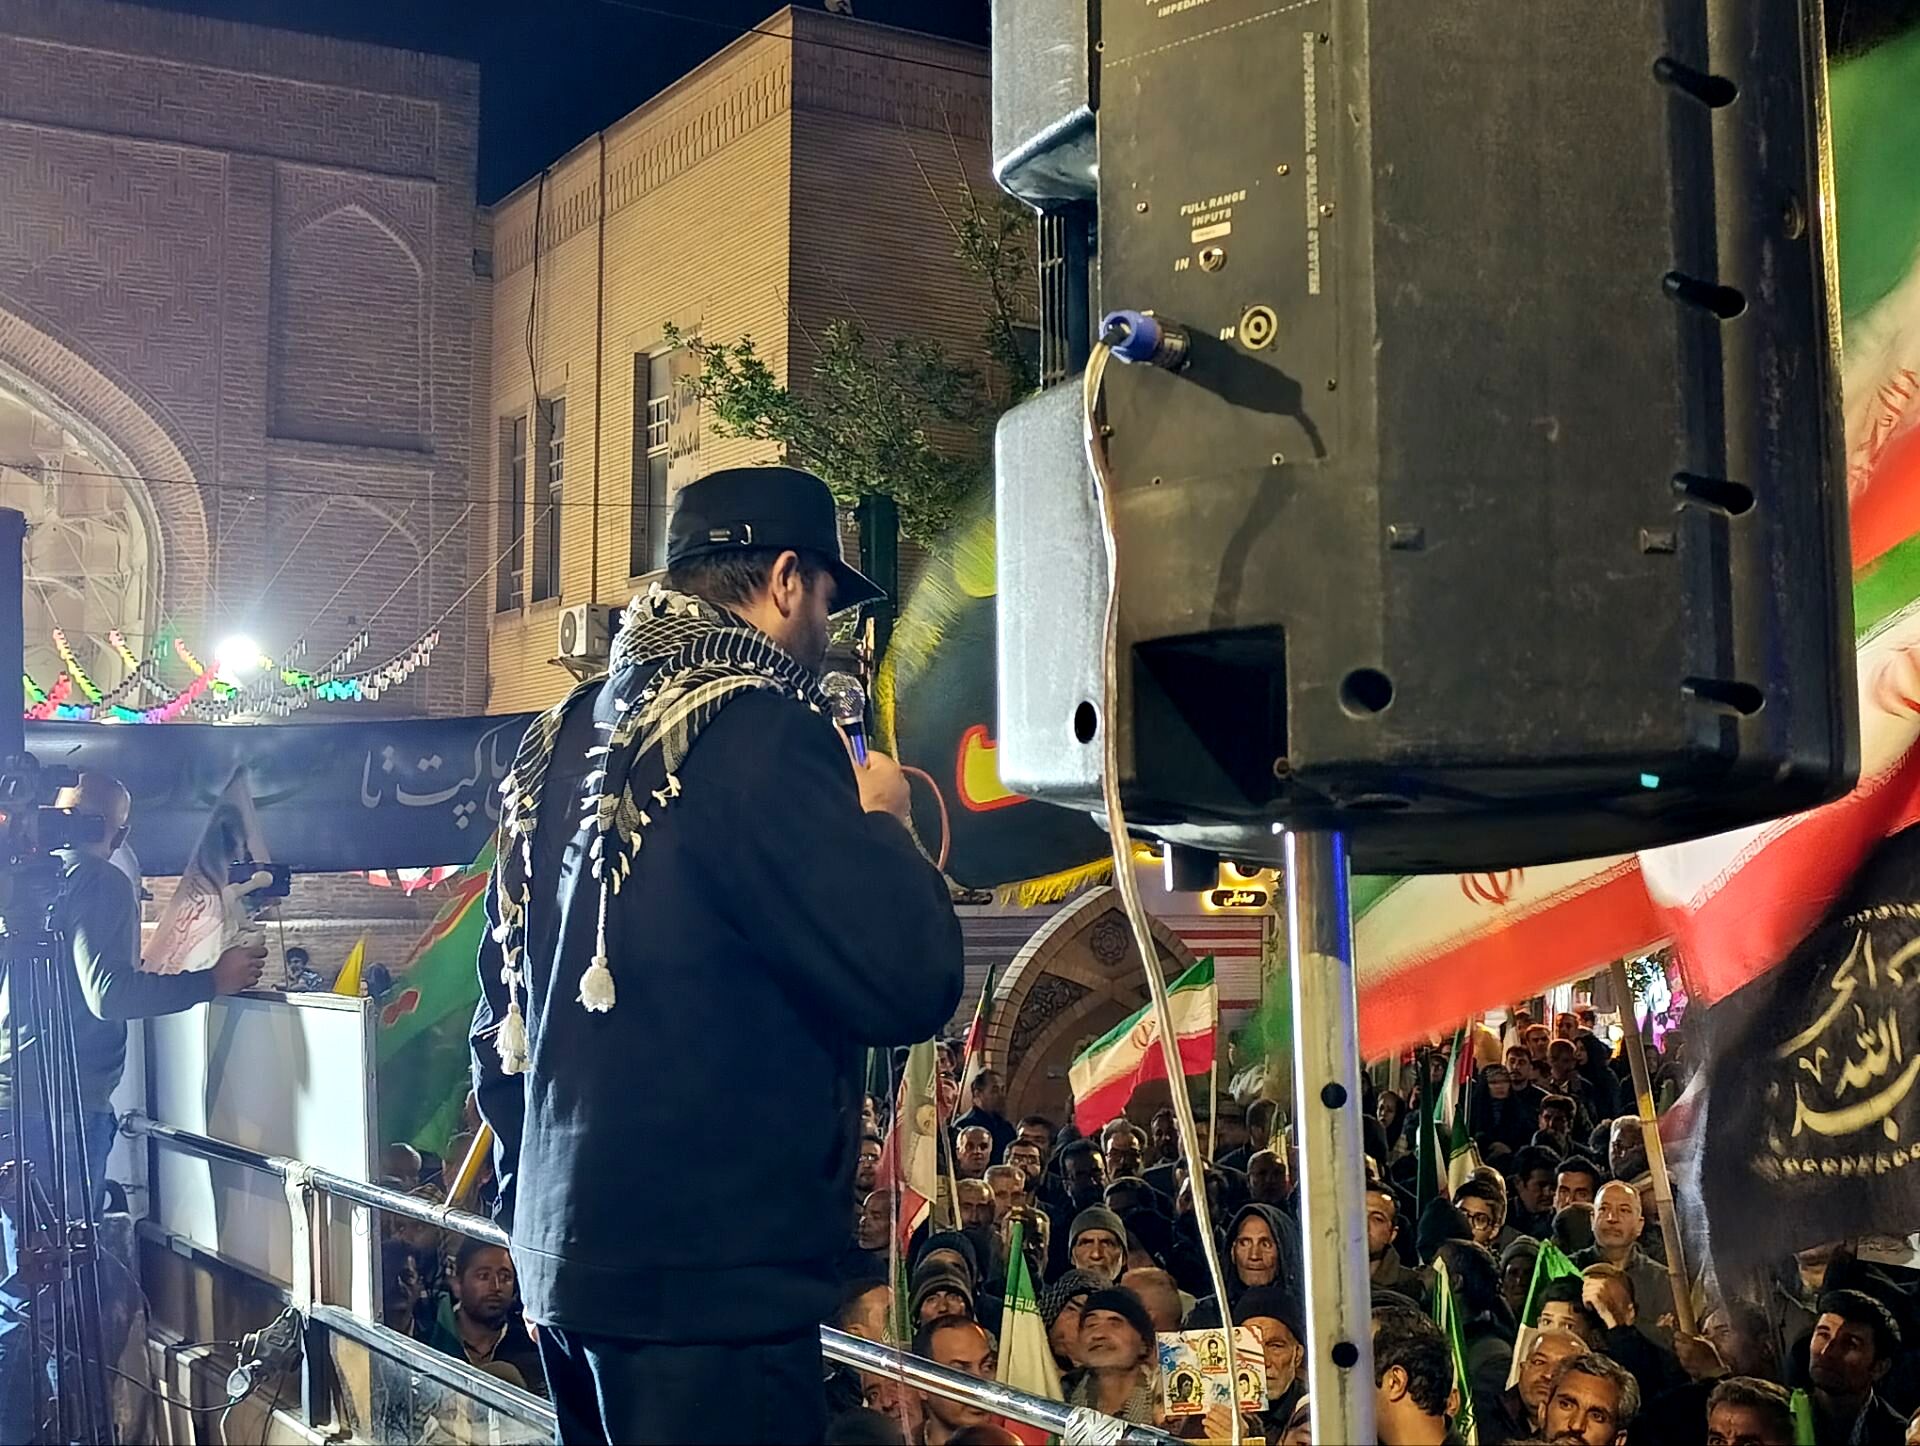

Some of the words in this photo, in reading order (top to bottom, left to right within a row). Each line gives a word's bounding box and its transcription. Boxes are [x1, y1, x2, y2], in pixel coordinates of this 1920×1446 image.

[1303, 31, 1317, 153] PROFESSIONAL
[1180, 200, 1208, 217] FULL
[1208, 189, 1247, 209] RANGE
[1305, 154, 1319, 230] SPEAKER
[1191, 207, 1232, 228] INPUTS
[1174, 256, 1190, 272] IN
[1307, 230, 1320, 295] SYSTEM
[1219, 325, 1236, 341] IN
